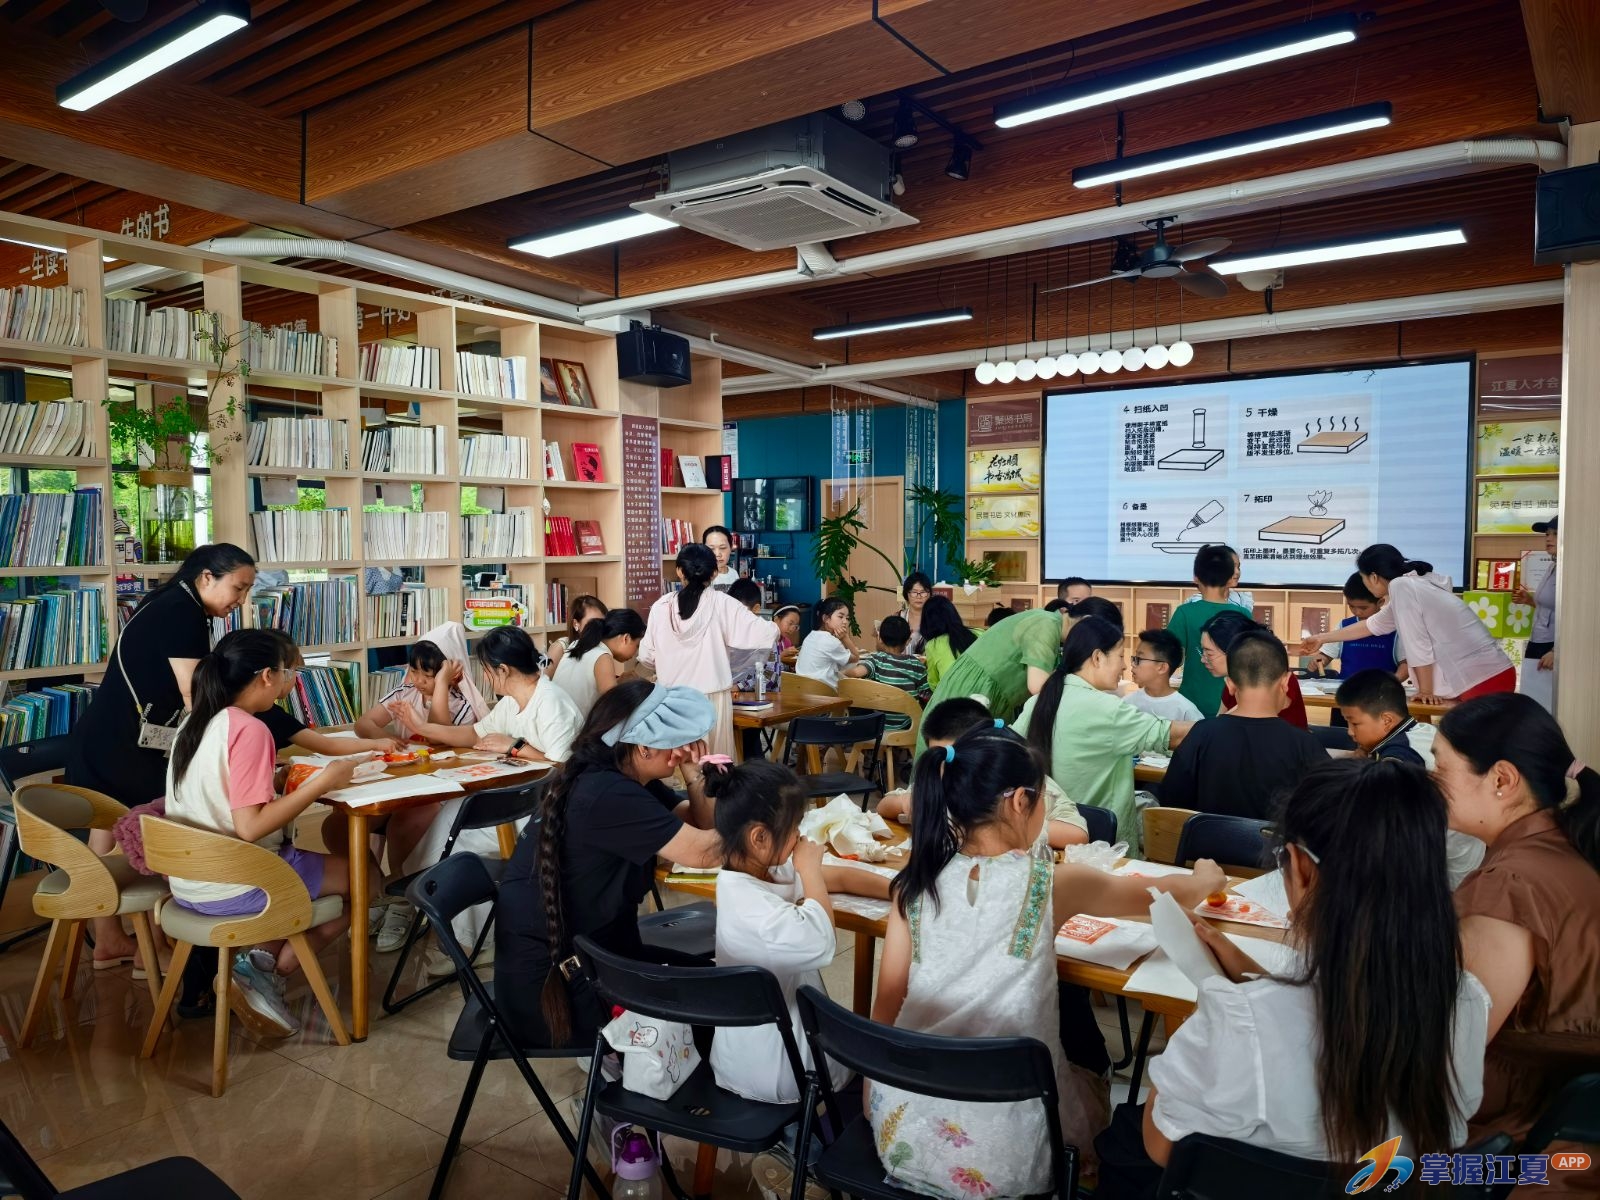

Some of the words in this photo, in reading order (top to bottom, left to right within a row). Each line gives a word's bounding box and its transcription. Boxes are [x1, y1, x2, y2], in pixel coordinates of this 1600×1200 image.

[1123, 405, 1130, 414] 4
[1134, 404, 1169, 413] 扫纸入凹
[1246, 408, 1252, 417] 5
[1257, 407, 1278, 417] 干燥
[1243, 494, 1250, 503] 7
[1254, 495, 1273, 503] 拓印
[1122, 502, 1128, 510] 6
[1132, 502, 1147, 510] 备墨
